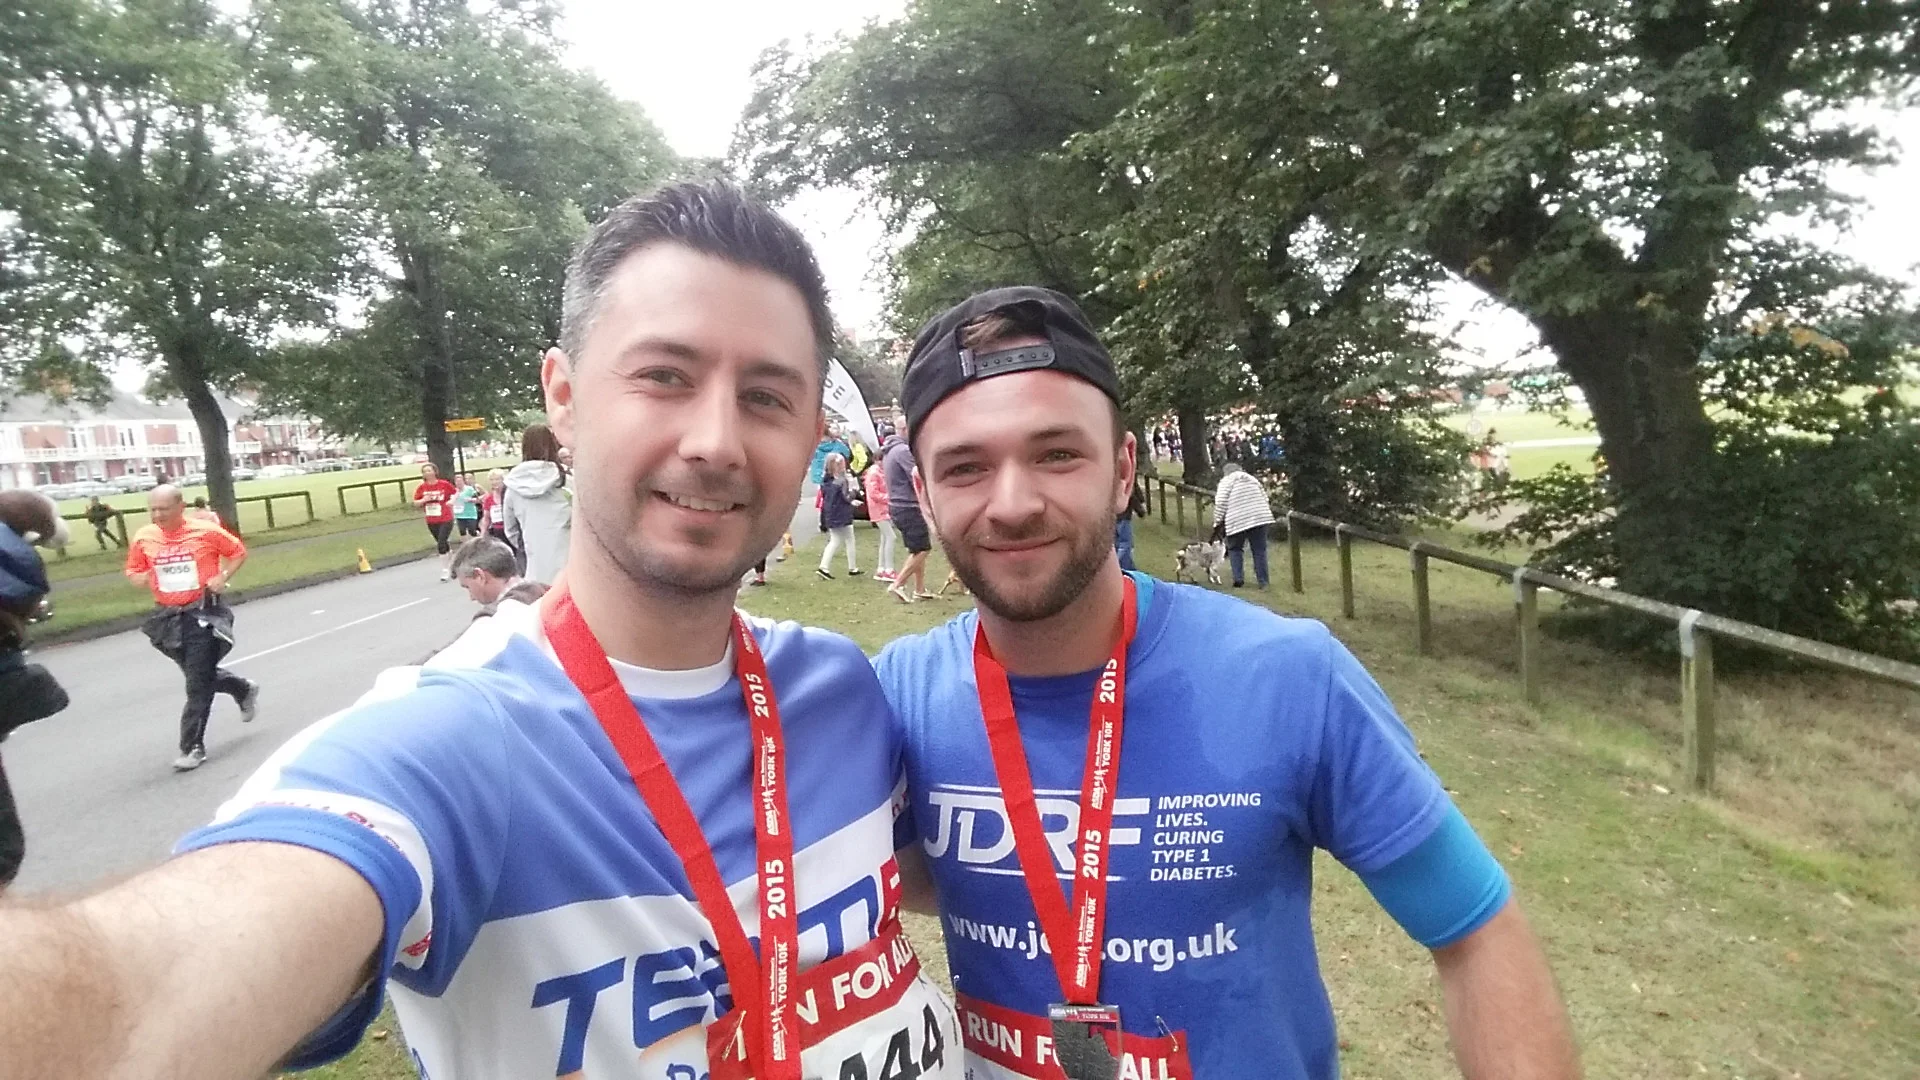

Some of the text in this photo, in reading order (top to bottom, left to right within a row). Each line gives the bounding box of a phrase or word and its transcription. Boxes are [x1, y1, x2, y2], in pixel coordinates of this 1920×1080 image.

[745, 673, 770, 719] 2015
[1099, 658, 1118, 704] 2015
[767, 755, 776, 787] YORK
[1156, 812, 1208, 828] LIVES.
[1158, 793, 1261, 810] IMPROVING
[1082, 829, 1101, 880] 2015
[1151, 848, 1210, 864] TYPE 1
[1153, 830, 1225, 846] CURING
[765, 859, 787, 920] 2015
[1150, 865, 1237, 882] DIABETES.
[778, 942, 788, 1003] YORK 10K
[832, 952, 894, 1011] FOR
[967, 1011, 1022, 1058] RUN
